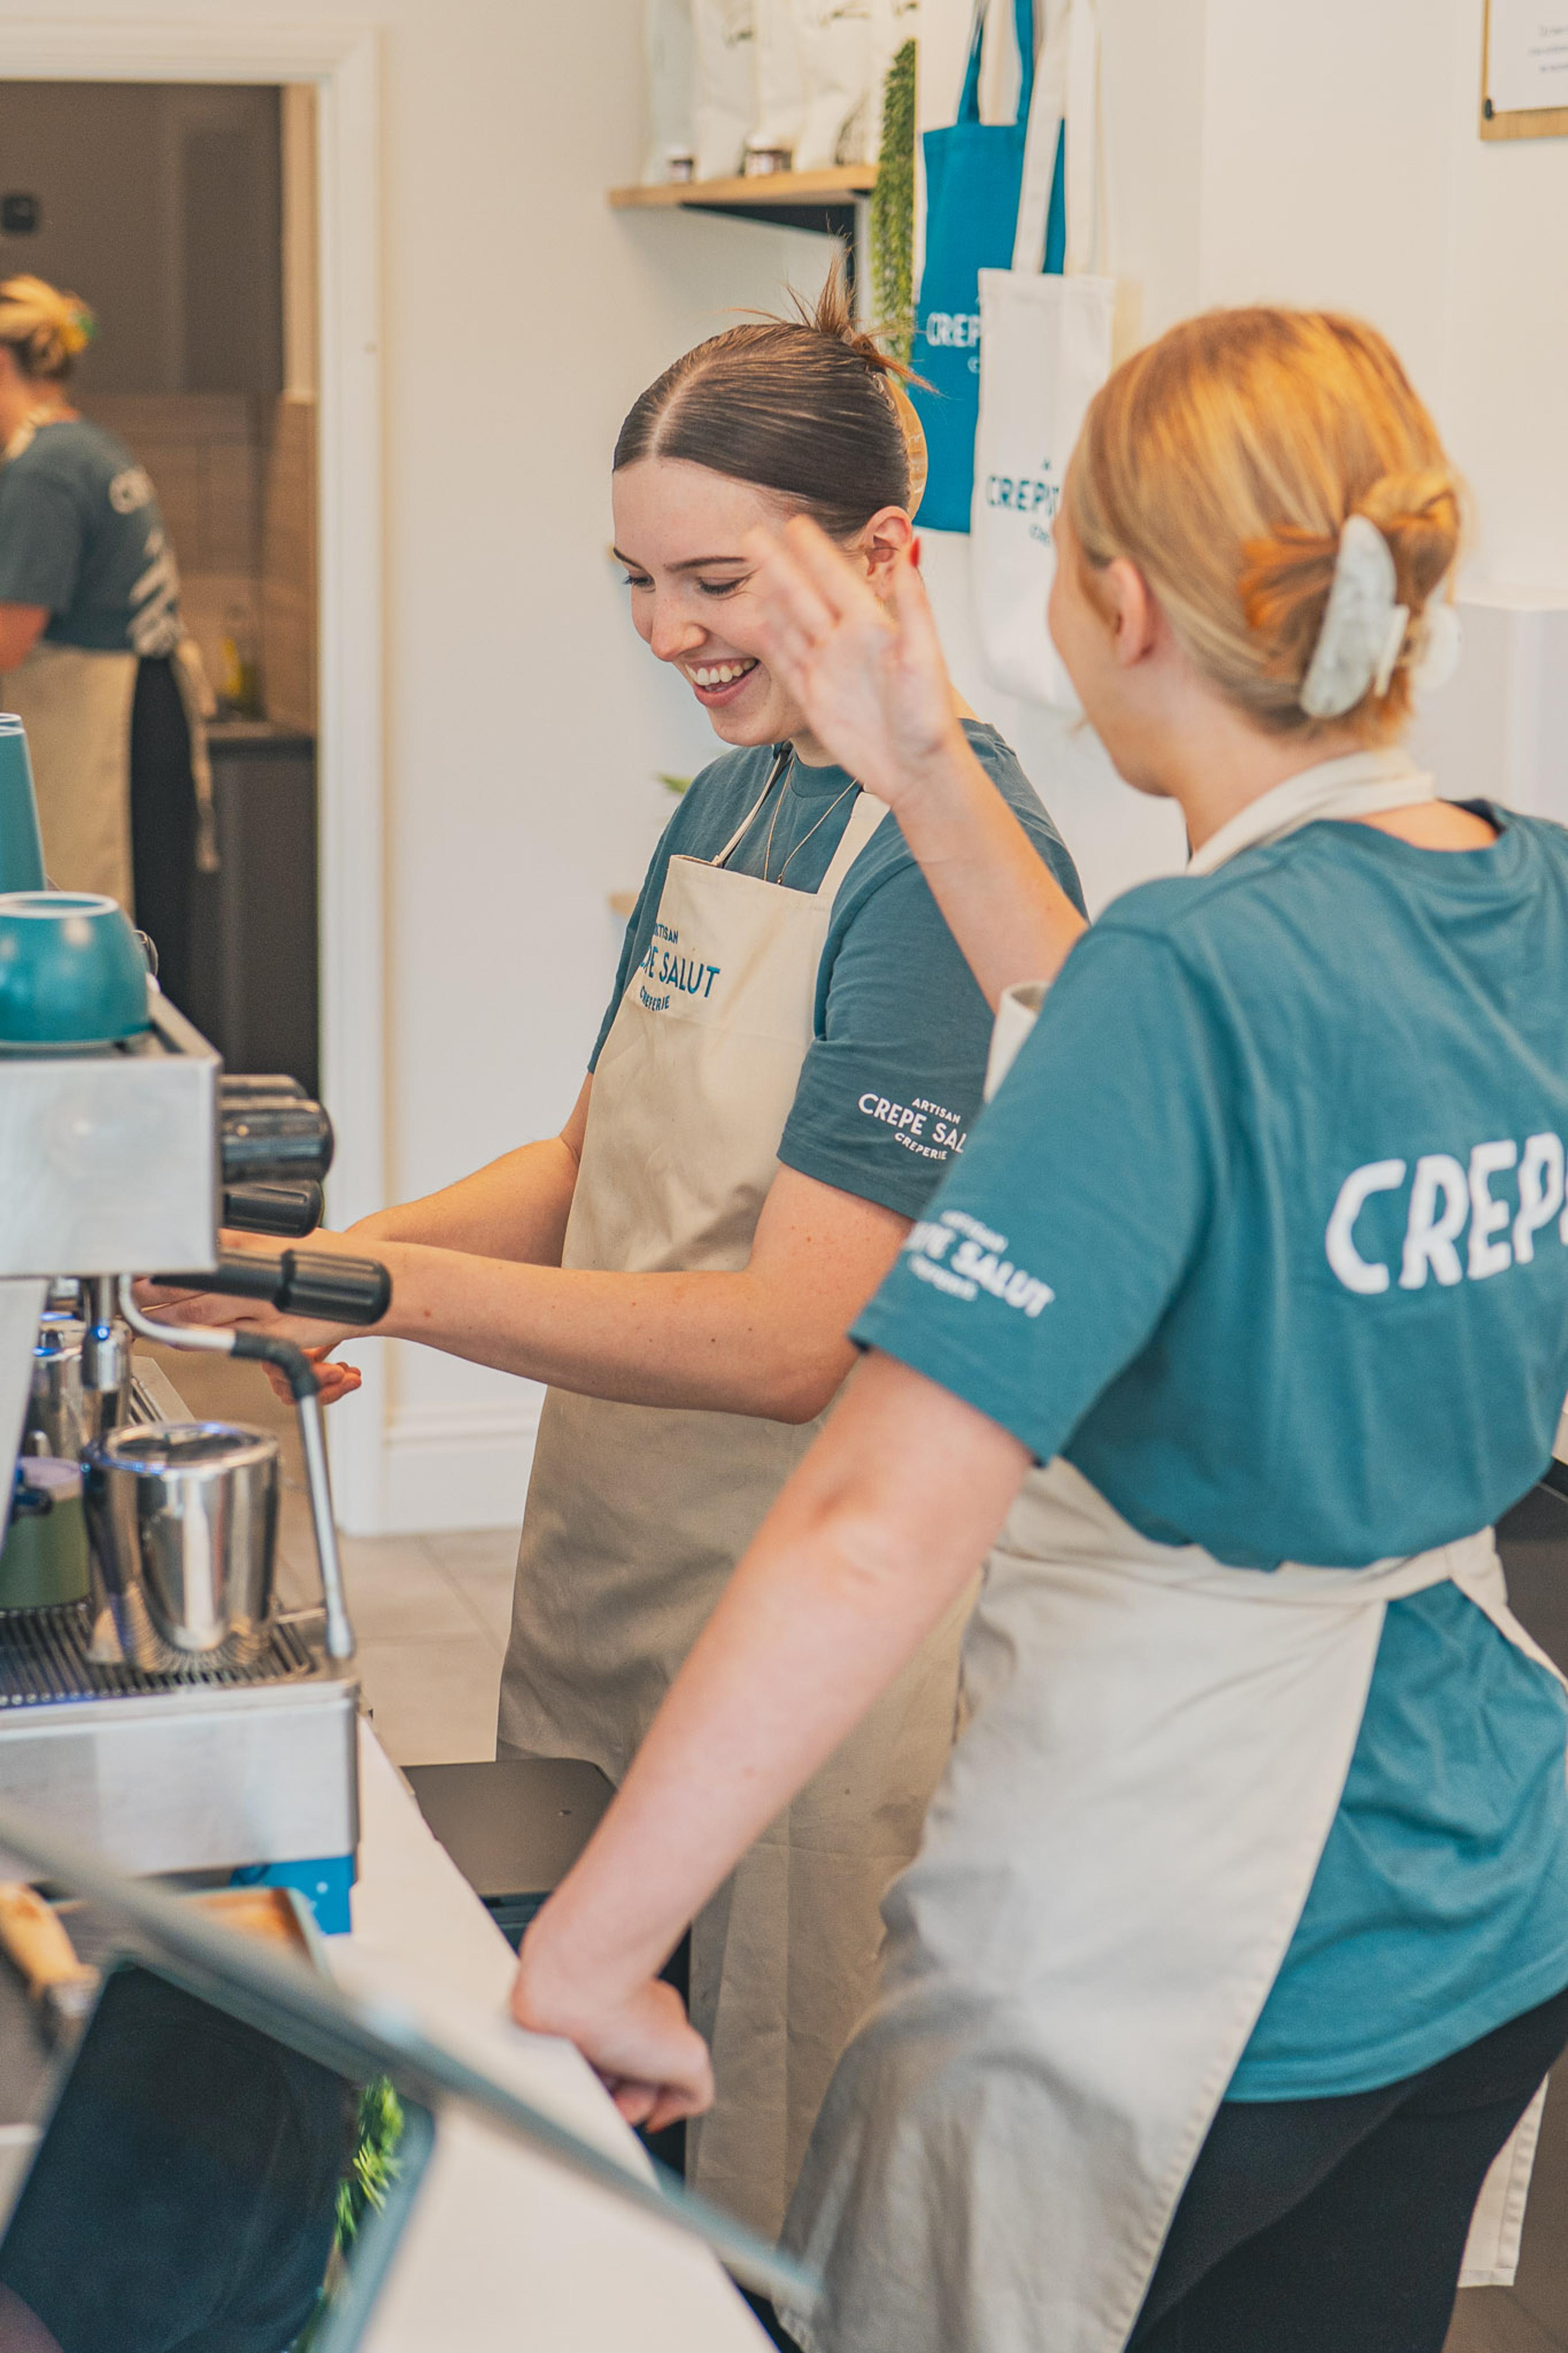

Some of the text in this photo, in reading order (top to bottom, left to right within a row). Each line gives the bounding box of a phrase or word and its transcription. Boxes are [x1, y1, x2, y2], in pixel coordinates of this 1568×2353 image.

[659, 952, 721, 998] SALUT
[640, 986, 670, 1012] CREPERIE
[858, 1093, 967, 1153] CREPE SAL
[911, 1097, 961, 1124] ARTISAN
[894, 1132, 947, 1160] CREPERIE
[1325, 1132, 1568, 1295] CREP
[951, 1240, 1056, 1318] SALUT
